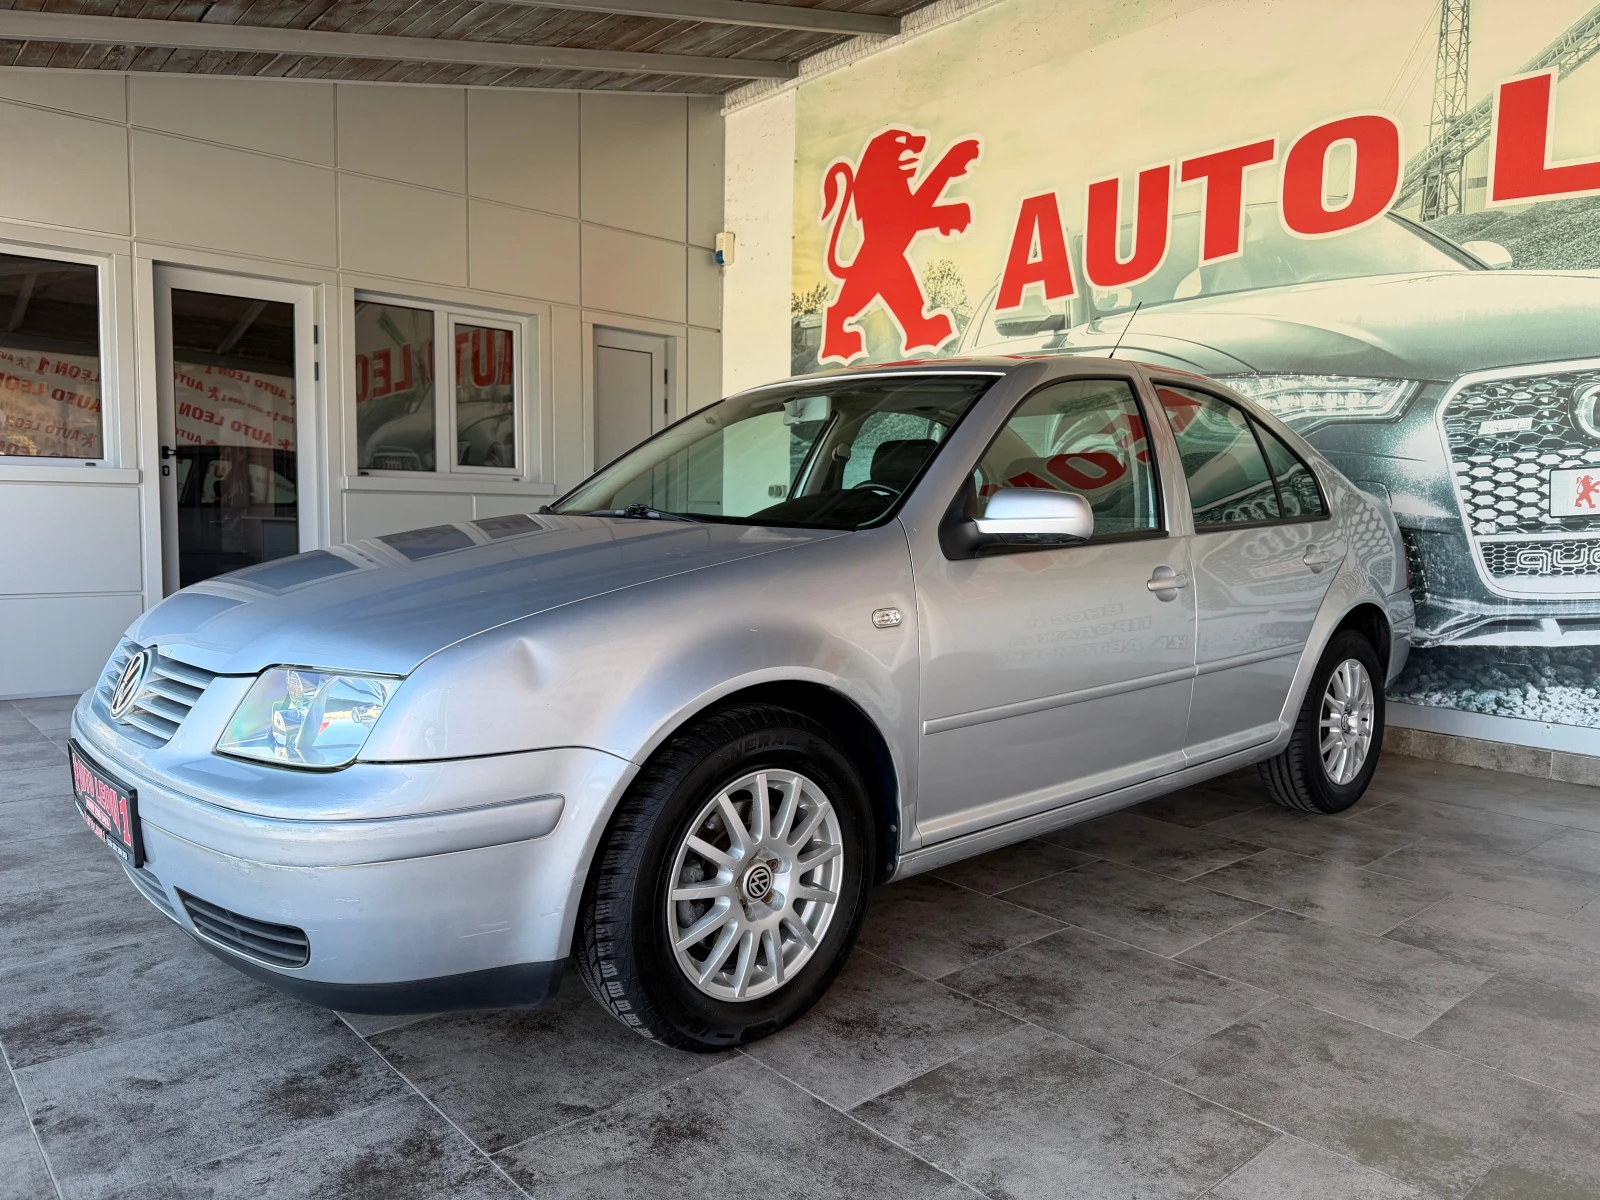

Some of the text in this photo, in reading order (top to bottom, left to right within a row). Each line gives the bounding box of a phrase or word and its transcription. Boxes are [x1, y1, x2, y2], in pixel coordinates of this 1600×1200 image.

[994, 73, 1600, 310] AUTO L
[119, 796, 131, 847] 1
